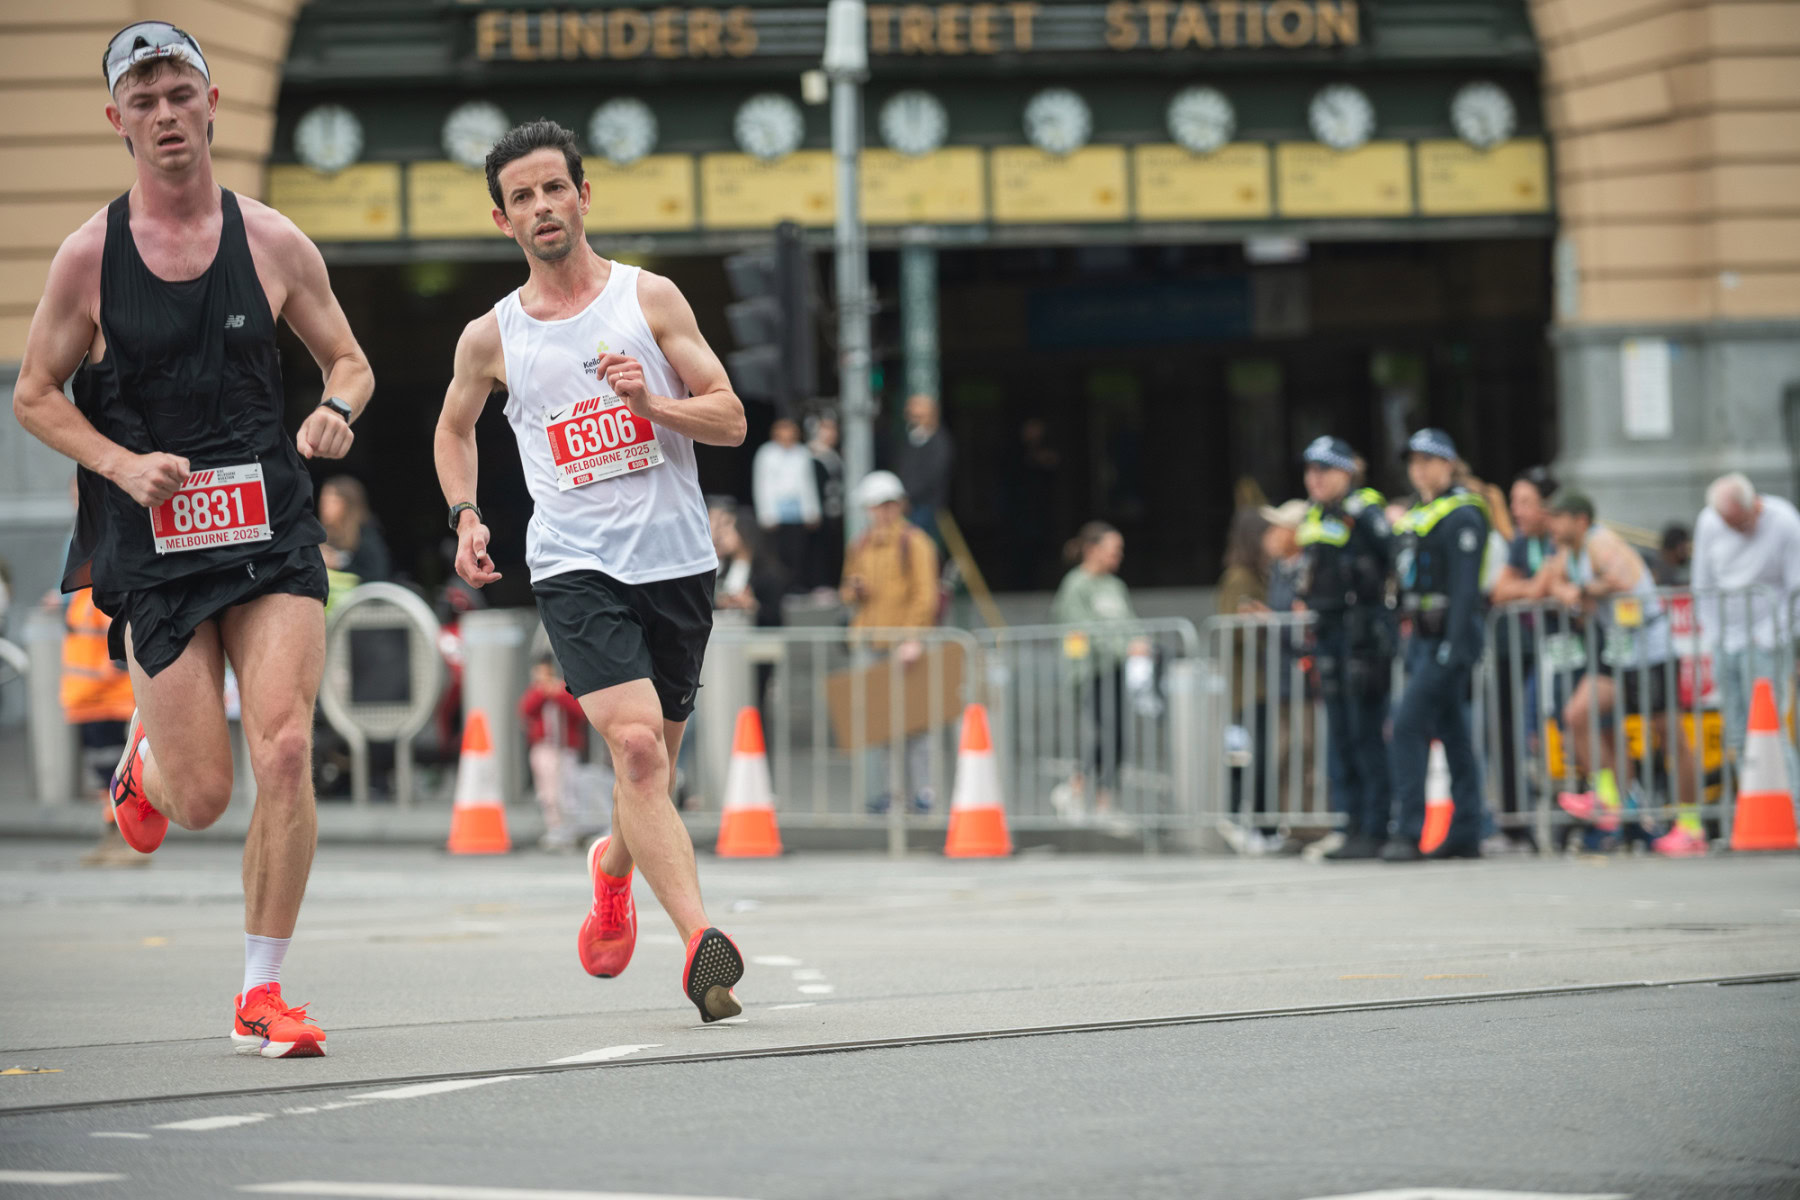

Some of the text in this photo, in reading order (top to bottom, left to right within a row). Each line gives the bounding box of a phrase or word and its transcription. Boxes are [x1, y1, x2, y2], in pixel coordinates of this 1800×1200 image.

[476, 0, 1360, 60] FLINDERS TREET STATION
[583, 357, 601, 369] Keilo
[564, 409, 637, 458] 6306
[564, 444, 650, 475] MELBOURNE 2025
[172, 487, 245, 533] 8831
[165, 527, 260, 550] MELBOURNE 2025
